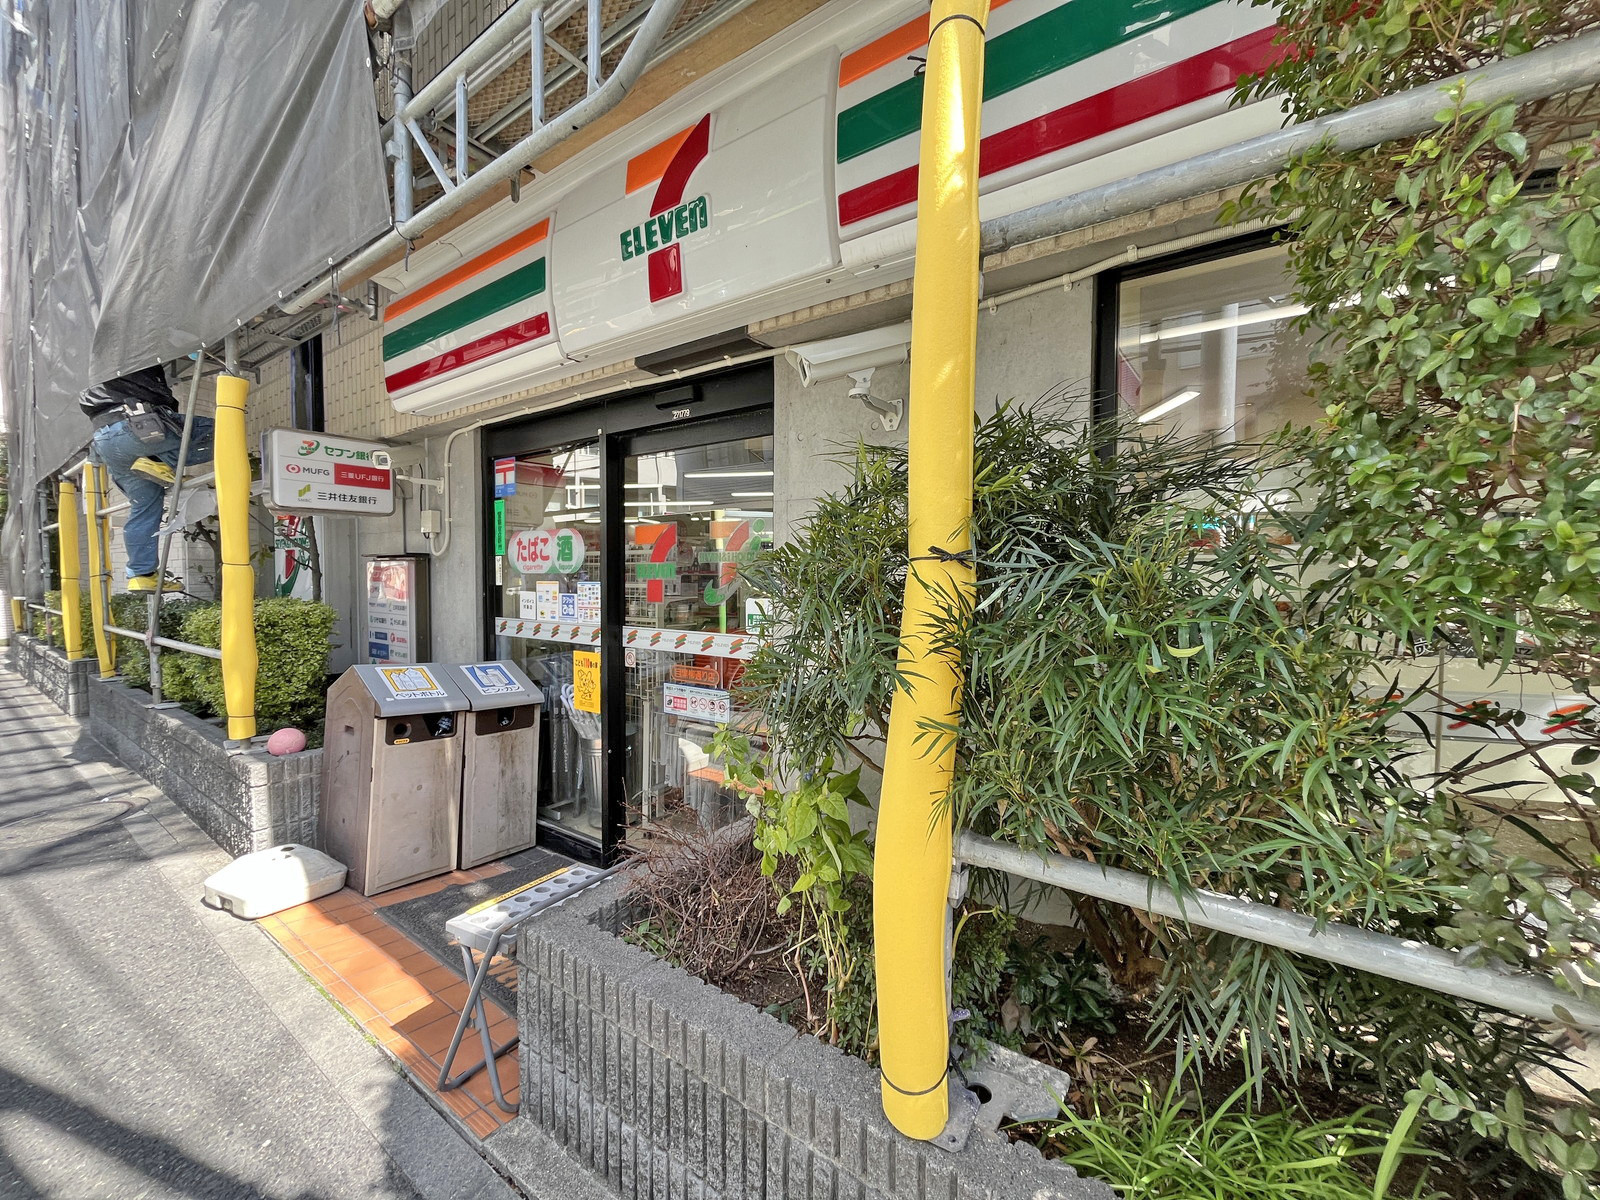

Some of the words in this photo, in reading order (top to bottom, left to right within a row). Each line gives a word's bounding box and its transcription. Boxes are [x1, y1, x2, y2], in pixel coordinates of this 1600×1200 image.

[303, 466, 330, 476] MUFG
[340, 471, 385, 483] 三菱UFJ銀行
[317, 491, 377, 505] 三井住友銀行
[516, 535, 550, 562] たばこ
[556, 535, 573, 562] 酒
[395, 690, 445, 698] ペットボトル
